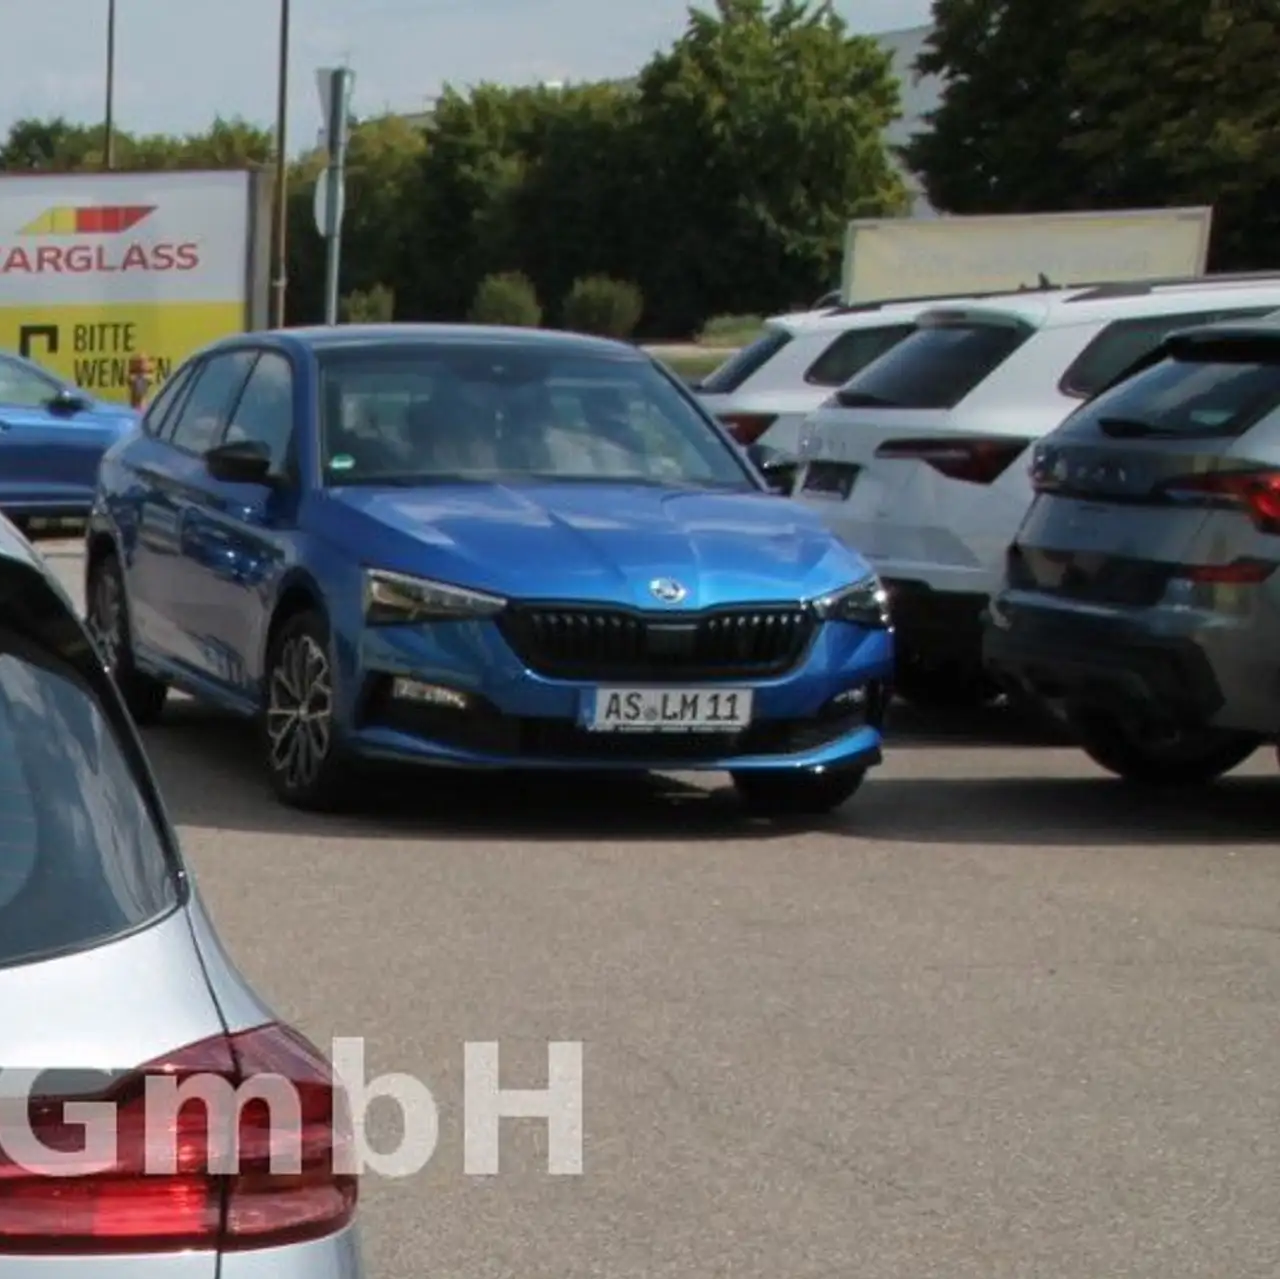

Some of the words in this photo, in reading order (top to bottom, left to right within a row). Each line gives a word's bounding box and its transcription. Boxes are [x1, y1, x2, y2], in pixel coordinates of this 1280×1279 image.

[73, 322, 136, 353] BITTE
[73, 356, 173, 388] WENEN
[605, 692, 642, 721] AS
[661, 694, 699, 721] LM
[705, 694, 739, 721] 11
